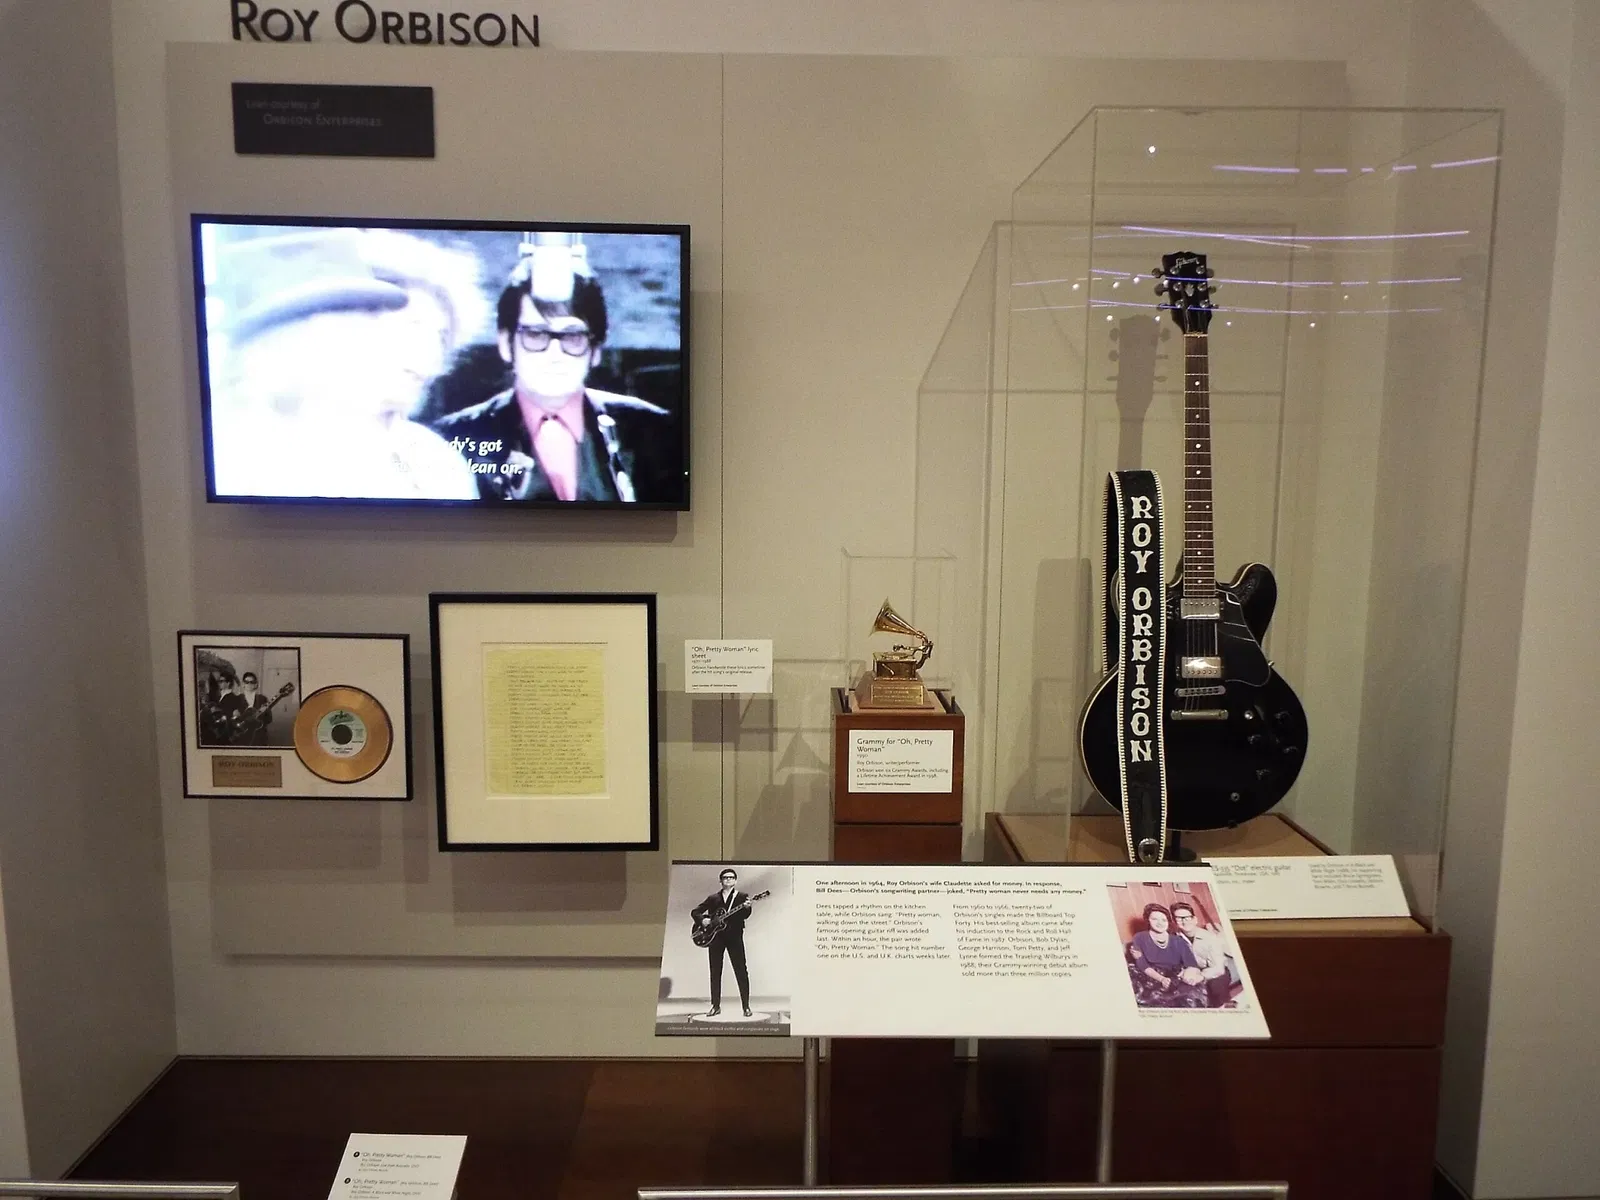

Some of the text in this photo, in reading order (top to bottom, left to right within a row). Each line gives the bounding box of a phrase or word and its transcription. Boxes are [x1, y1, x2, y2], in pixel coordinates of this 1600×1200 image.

[231, 0, 540, 47] ROY ORBISON
[479, 440, 502, 456] got
[467, 459, 522, 474] lean on.
[1130, 495, 1154, 574] ROY
[1130, 586, 1153, 763] ORBISON
[915, 738, 933, 746] Pretty
